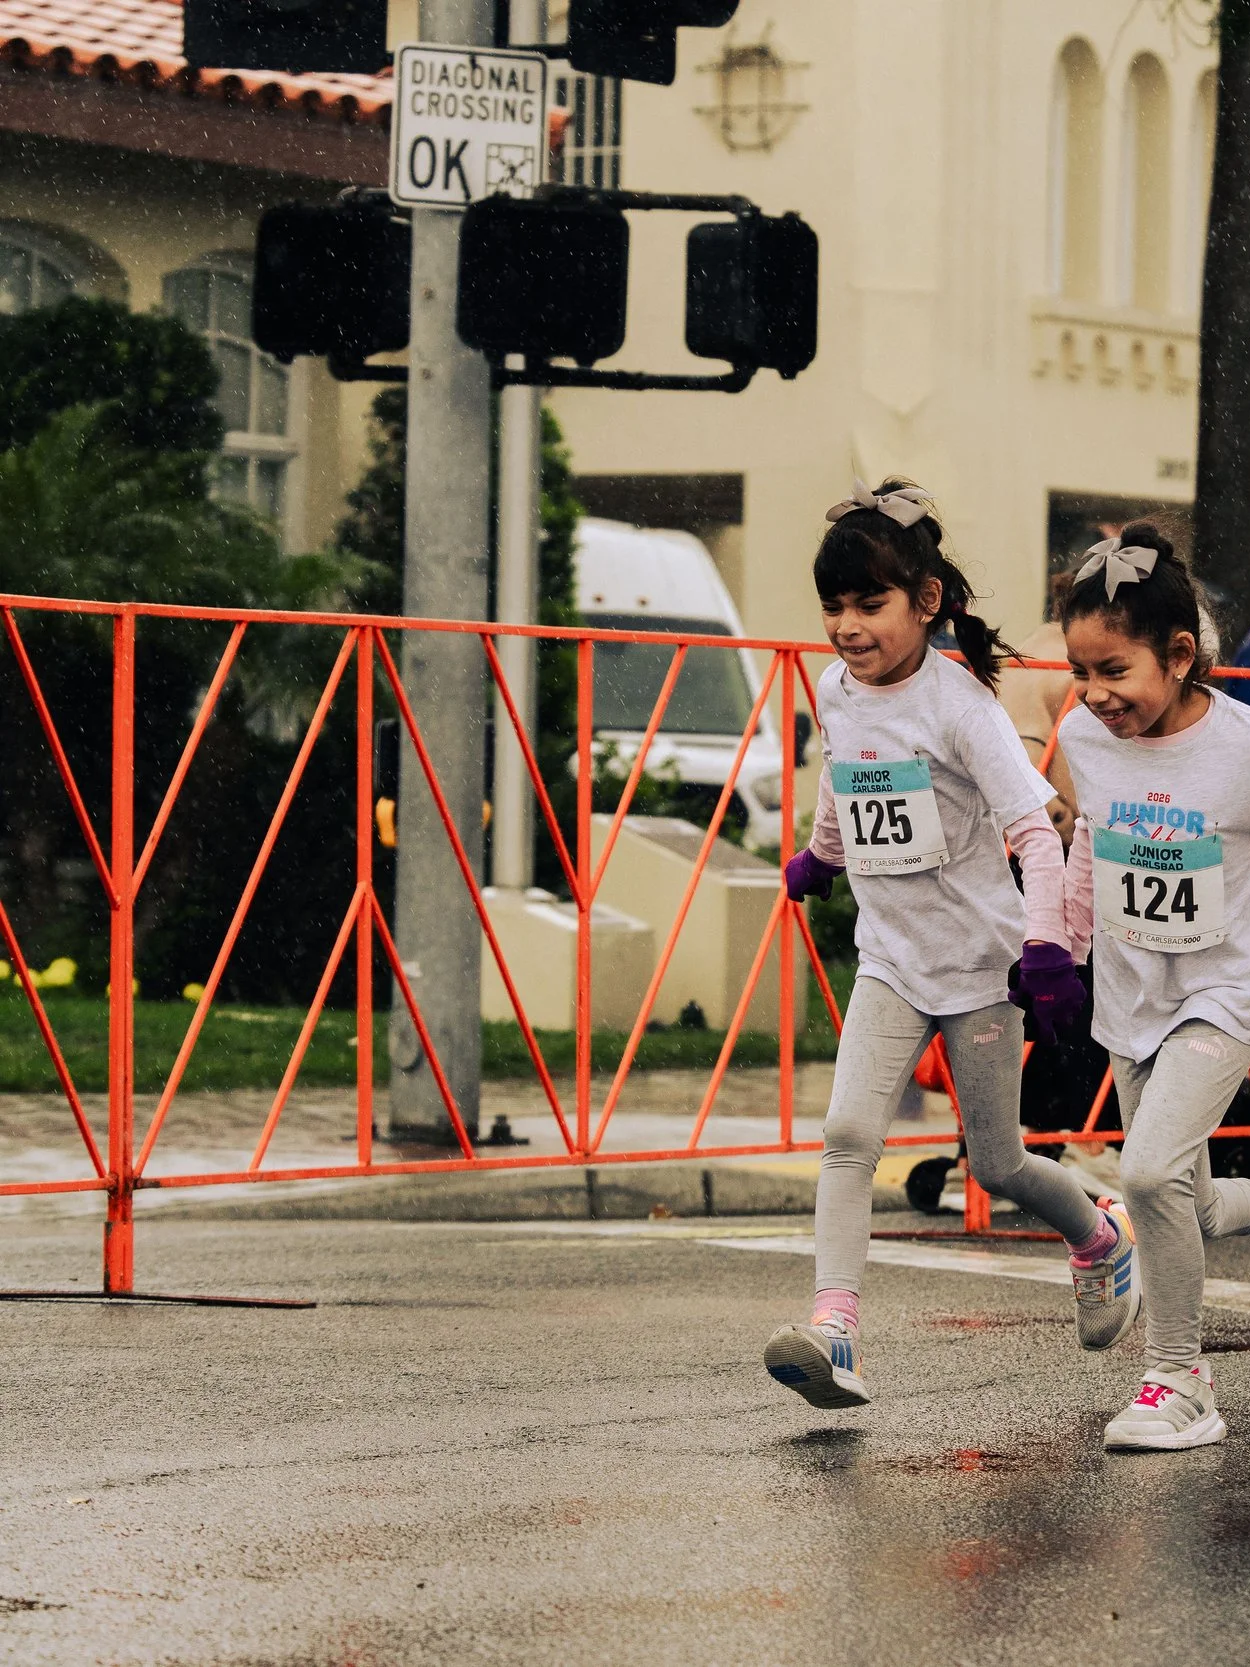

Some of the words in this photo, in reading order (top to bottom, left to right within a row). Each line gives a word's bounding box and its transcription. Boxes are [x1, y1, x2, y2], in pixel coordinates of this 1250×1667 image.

[411, 59, 536, 94] DIAGONAL
[410, 91, 534, 125] CROSSING
[409, 135, 471, 195] OK
[860, 750, 878, 760] 2026
[851, 770, 891, 784] JUNIOR
[852, 784, 893, 793] CARLSBAD
[1147, 792, 1171, 804] 2026
[849, 798, 913, 845] 125
[1107, 801, 1205, 836] JUNIOR
[1130, 843, 1183, 861] JUNIOR
[1130, 857, 1184, 871] CARLSBAD
[1121, 871, 1199, 923] 124
[973, 1031, 999, 1044] PUMA
[1187, 1039, 1221, 1059] PUMA
